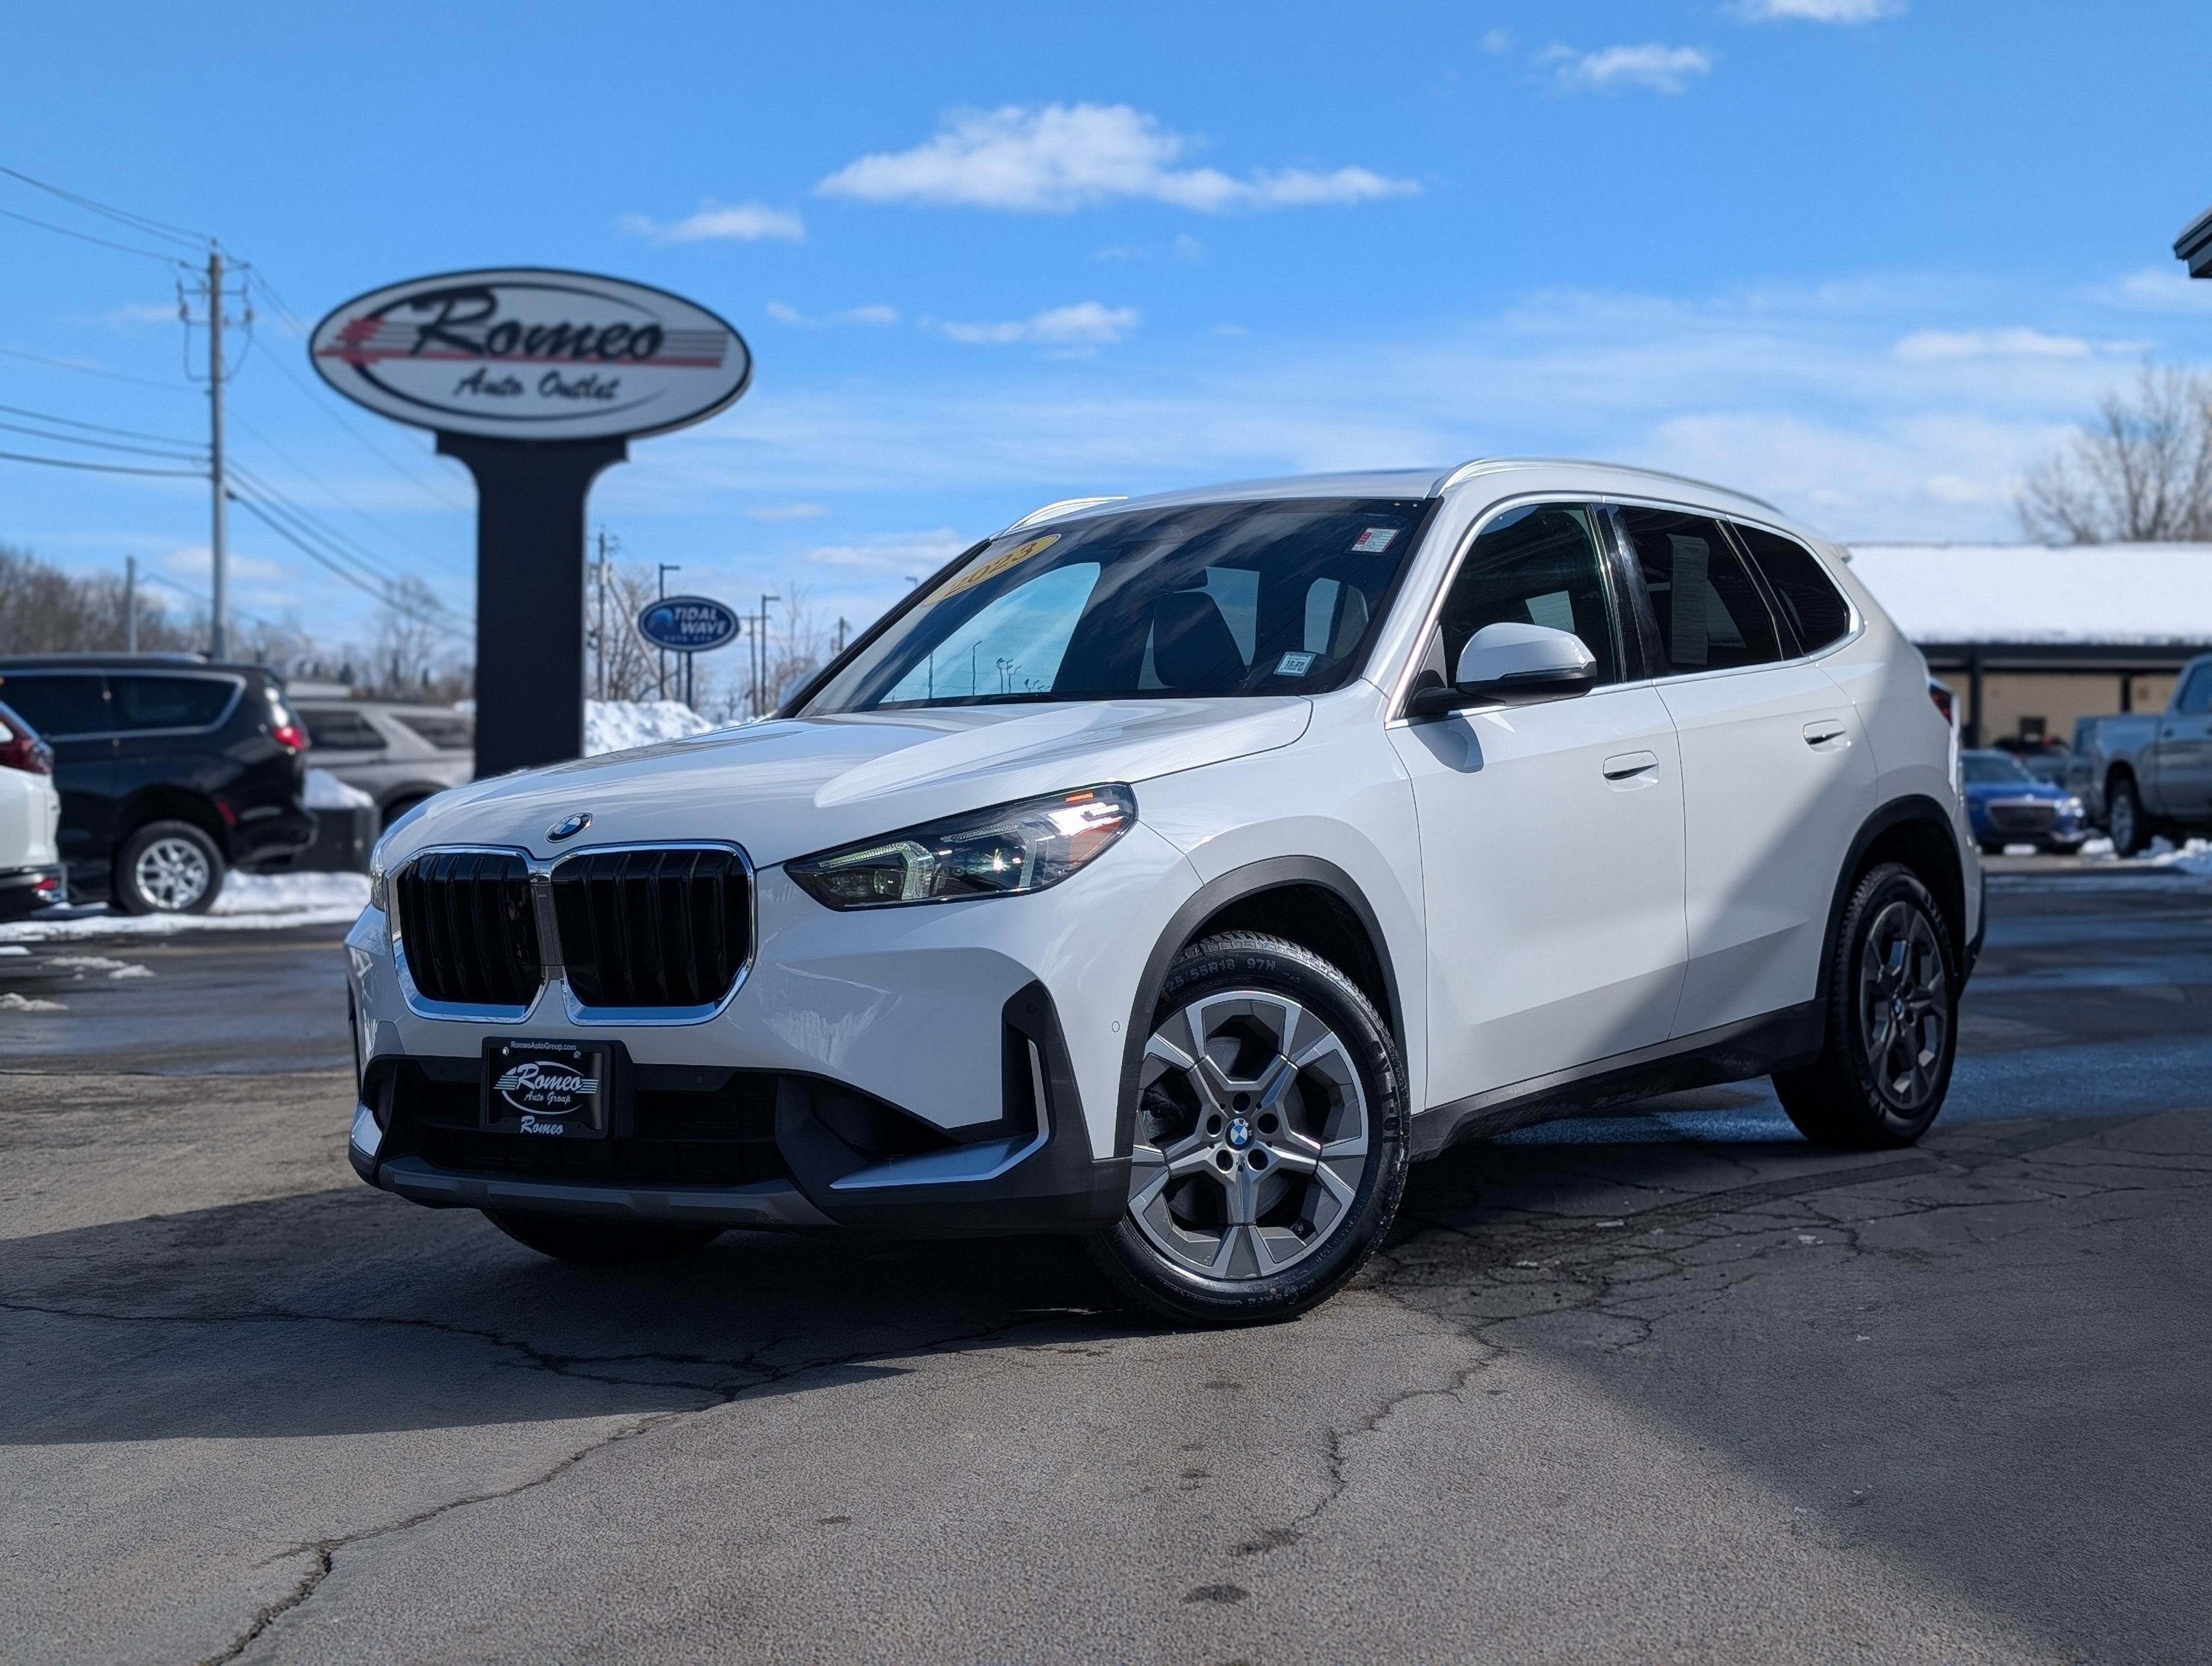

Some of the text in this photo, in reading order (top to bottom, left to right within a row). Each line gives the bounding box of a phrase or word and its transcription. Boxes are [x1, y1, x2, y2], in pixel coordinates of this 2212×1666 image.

[410, 286, 665, 360] Romeo
[453, 367, 621, 401] Auto Outlet
[944, 542, 1037, 597] 2023
[674, 607, 717, 621] TIDAL
[680, 619, 727, 635] WAVE
[511, 1041, 576, 1051] RomeoAutoGroup.com
[516, 1063, 583, 1091] Romeo
[524, 1090, 571, 1105] Auto Group
[520, 1116, 564, 1135] Romeo
